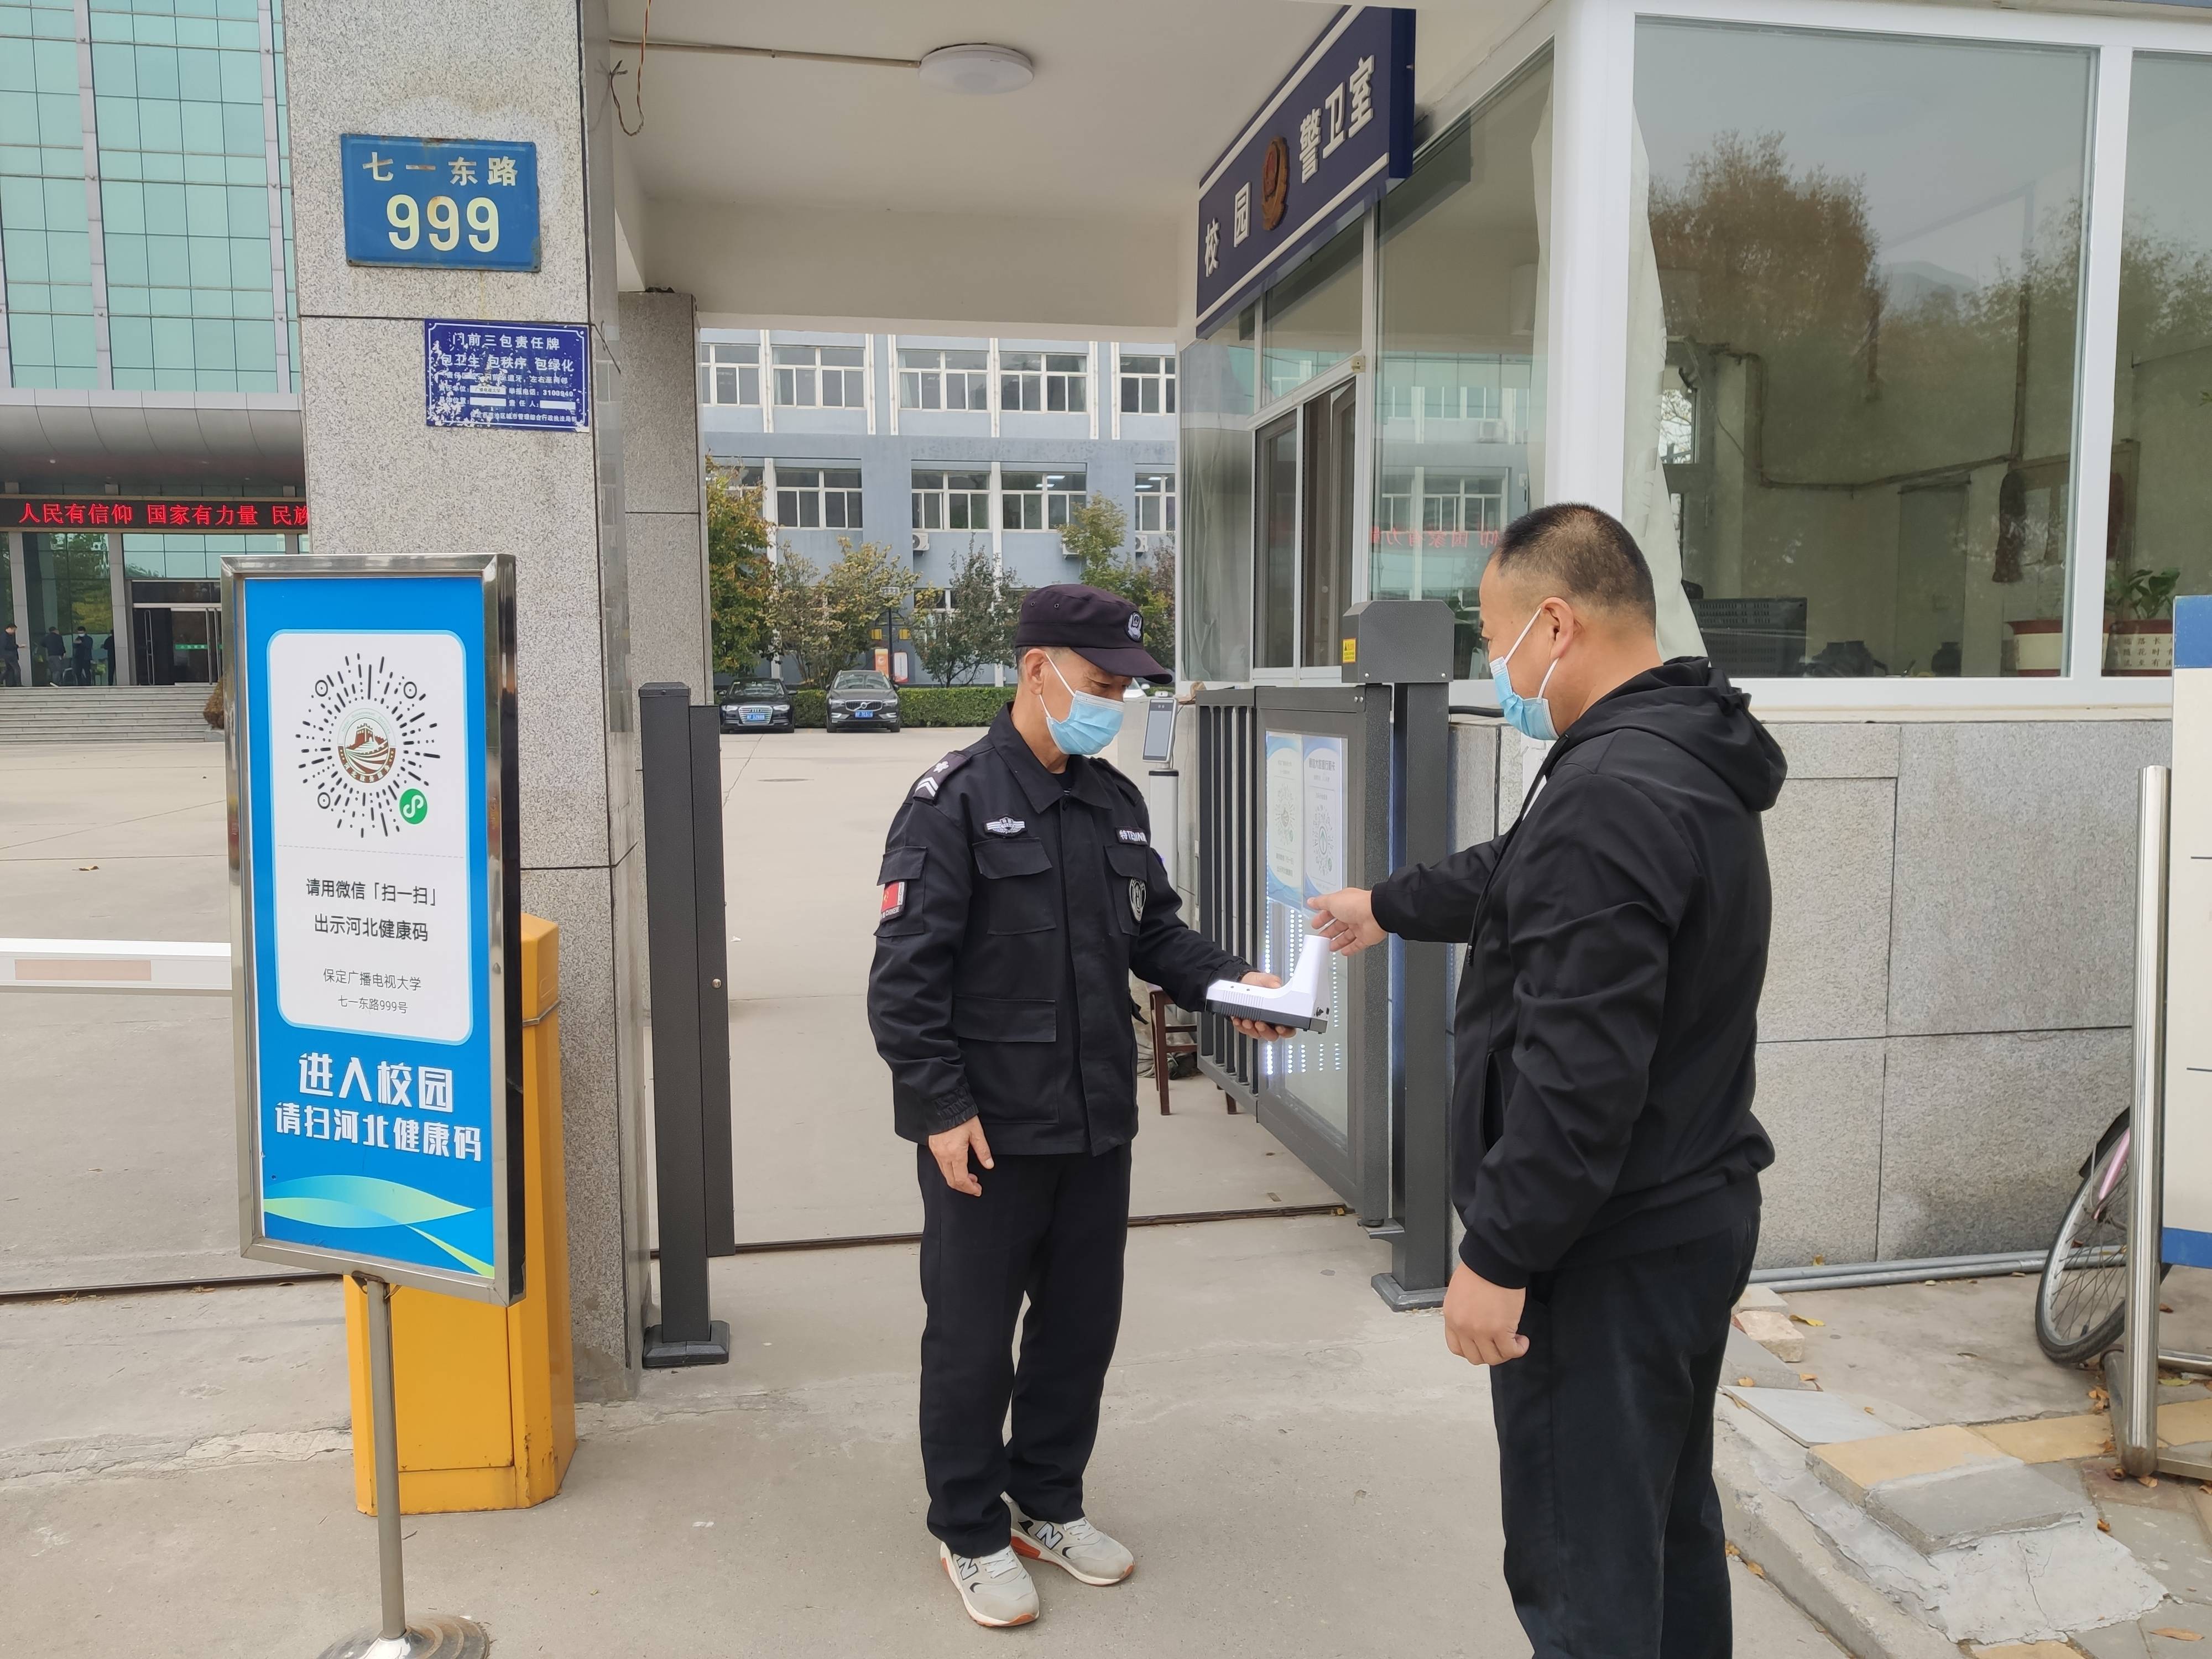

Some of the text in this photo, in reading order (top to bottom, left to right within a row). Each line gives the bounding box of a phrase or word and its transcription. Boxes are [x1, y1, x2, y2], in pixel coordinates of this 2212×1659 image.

[363, 152, 519, 186] 七一东路
[1204, 55, 1375, 277] 校园 警卫室
[387, 194, 499, 252] 999
[452, 332, 560, 351] 门前三包责任牌
[441, 353, 575, 372] 包卫生 包秩序 包绿化
[19, 503, 133, 525] 人民有信仰
[147, 504, 258, 526] 国家有力量
[306, 878, 436, 906] 请用微信「扫一扫」
[314, 913, 429, 942] 出示河北健康码
[323, 968, 422, 991] 保定广播电视大学
[338, 995, 408, 1014] 七一东路999号
[299, 1052, 454, 1113] 进入校园
[275, 1101, 482, 1162] 请扫河北健康码
